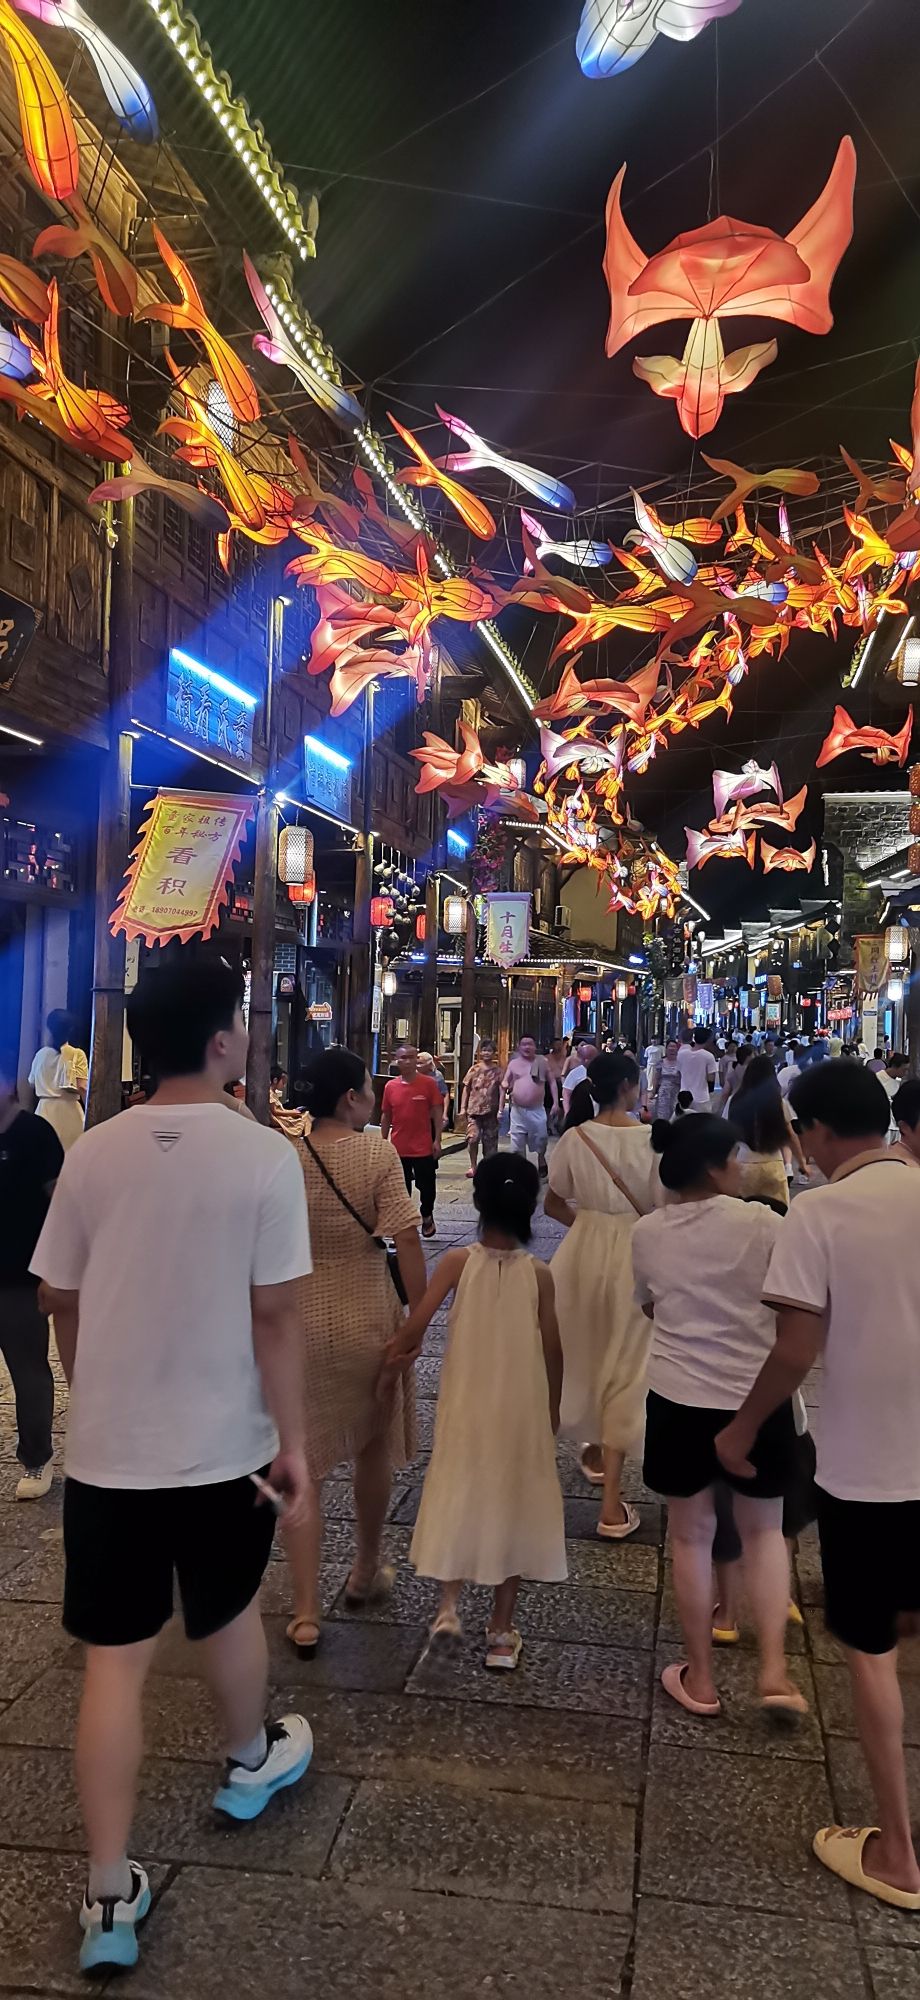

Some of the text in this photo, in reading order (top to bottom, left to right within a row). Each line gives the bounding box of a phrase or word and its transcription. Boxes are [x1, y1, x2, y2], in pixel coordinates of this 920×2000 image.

[162, 825, 222, 842] 百年秘方
[166, 810, 228, 828] 童家祖传
[156, 847, 199, 897] 看积
[499, 911, 517, 954] 十月生
